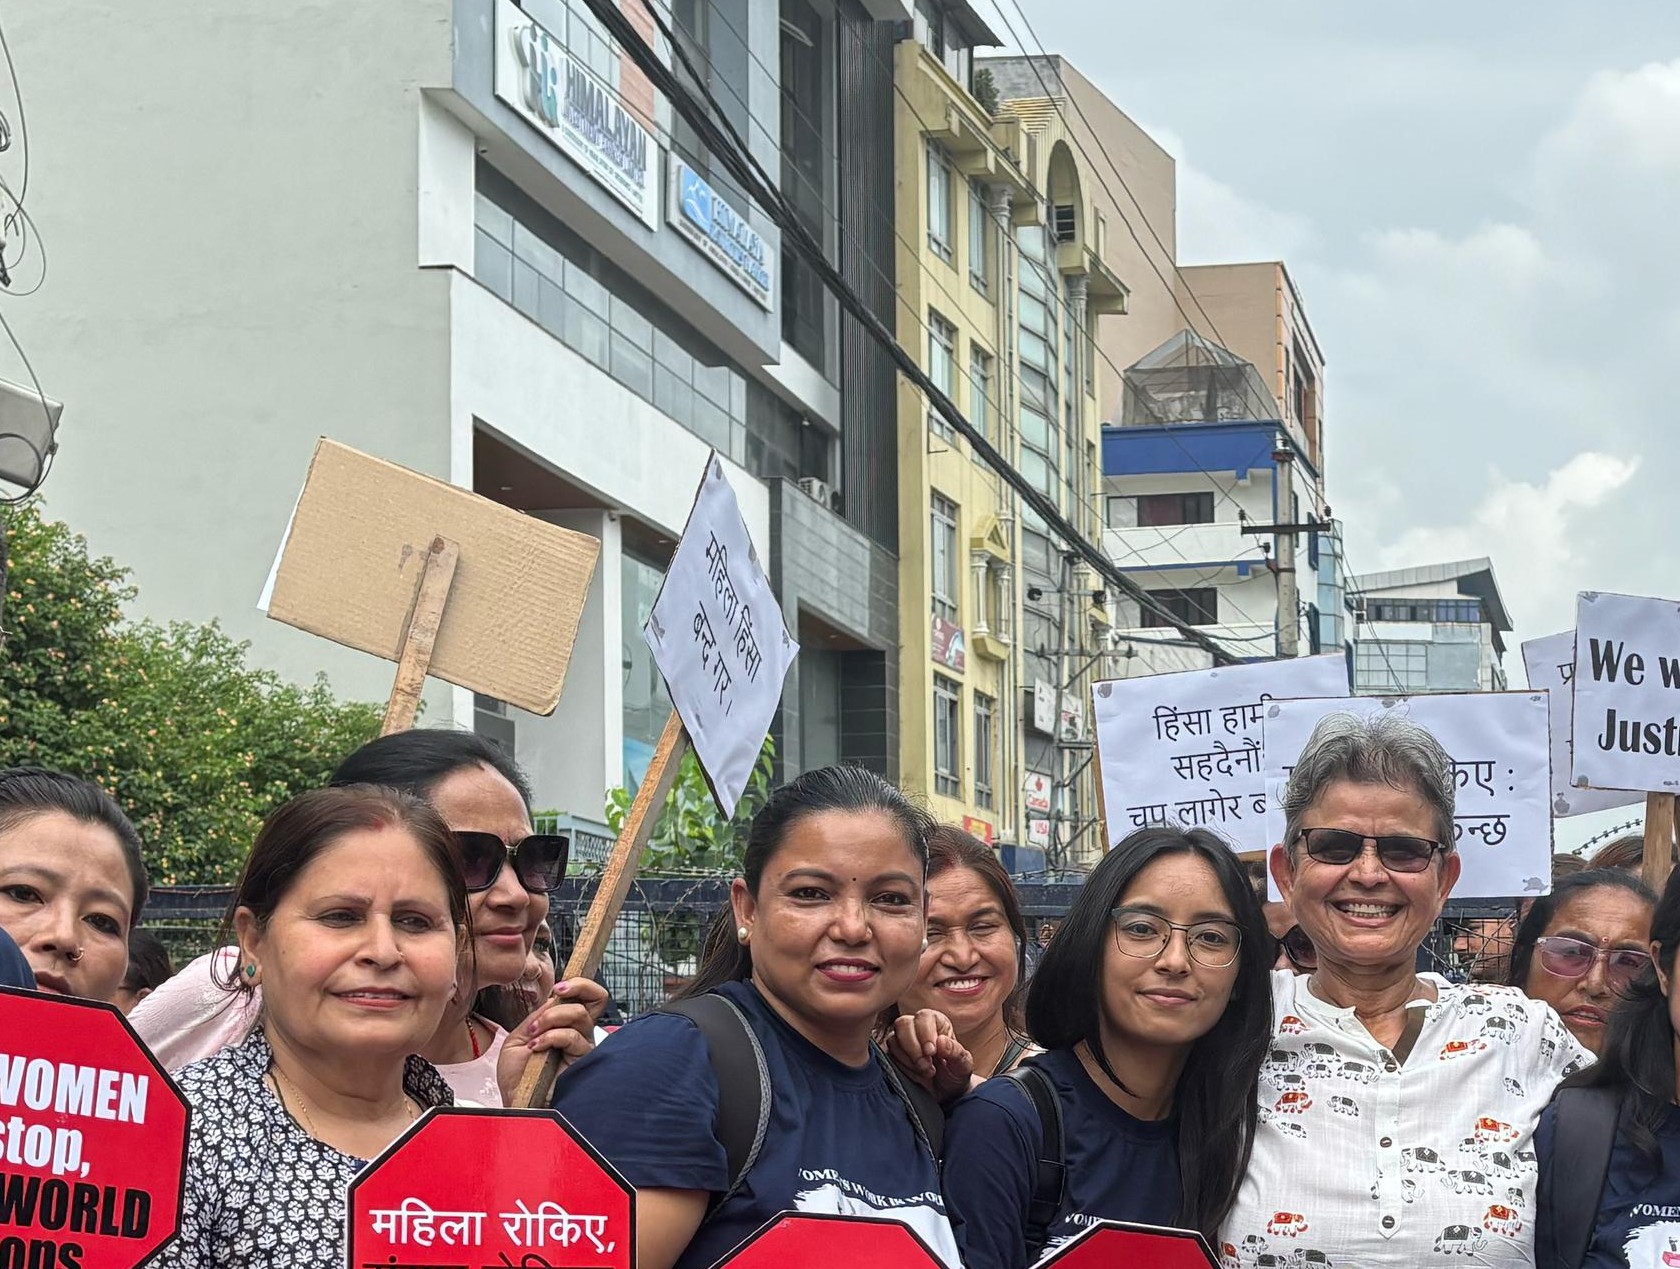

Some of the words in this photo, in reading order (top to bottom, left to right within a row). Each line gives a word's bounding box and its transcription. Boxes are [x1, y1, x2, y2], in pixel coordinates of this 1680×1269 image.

[693, 600, 716, 670] बन्द
[705, 530, 739, 626] महिला
[733, 604, 763, 684] हिंसा
[1589, 638, 1645, 686] We
[1152, 705, 1212, 742] हिंसा
[1175, 789, 1243, 826] लागेर
[0, 1114, 90, 1179] top,
[0, 1171, 152, 1239] WORLD
[369, 1197, 487, 1247] महिला
[499, 1199, 616, 1254] रोकिए,
